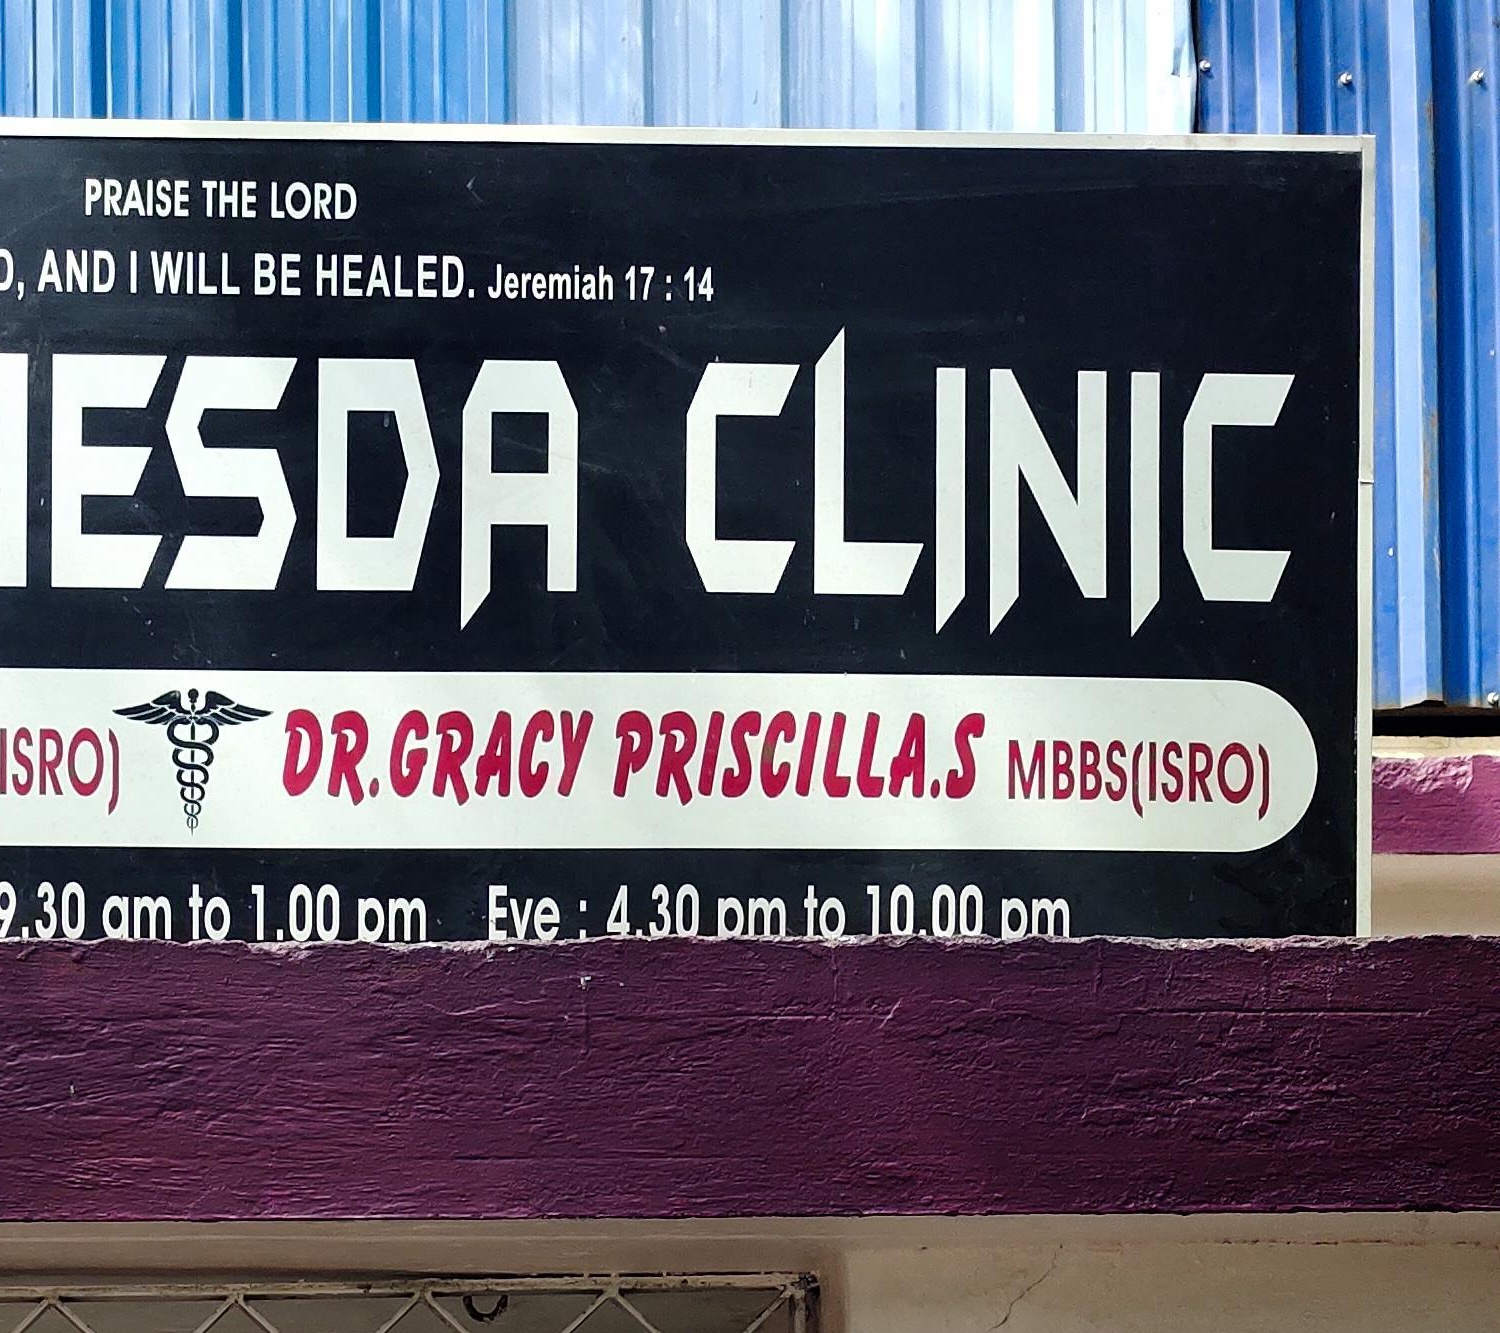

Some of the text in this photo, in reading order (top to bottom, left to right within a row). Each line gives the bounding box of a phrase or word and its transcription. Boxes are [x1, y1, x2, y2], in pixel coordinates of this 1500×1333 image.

[84, 178, 357, 220] PRAISE THE LORD
[37, 247, 116, 293] AND
[129, 250, 138, 294] I
[150, 250, 241, 295] WILL
[254, 252, 302, 296] BE
[316, 253, 475, 299] HEALED.
[487, 263, 614, 301] Jeremiah
[624, 265, 655, 301] 17
[683, 266, 714, 302] 14
[685, 329, 1296, 637] CLINIC
[282, 709, 1270, 821] DR.GRACY PRISCILLA.S MBBS(ISRO)
[101, 893, 173, 940] am
[188, 883, 232, 941] to
[251, 883, 340, 942] 1.00
[487, 883, 561, 941] Eve
[606, 883, 700, 937] 4.30
[803, 884, 846, 939] to
[866, 883, 984, 939] 10.00
